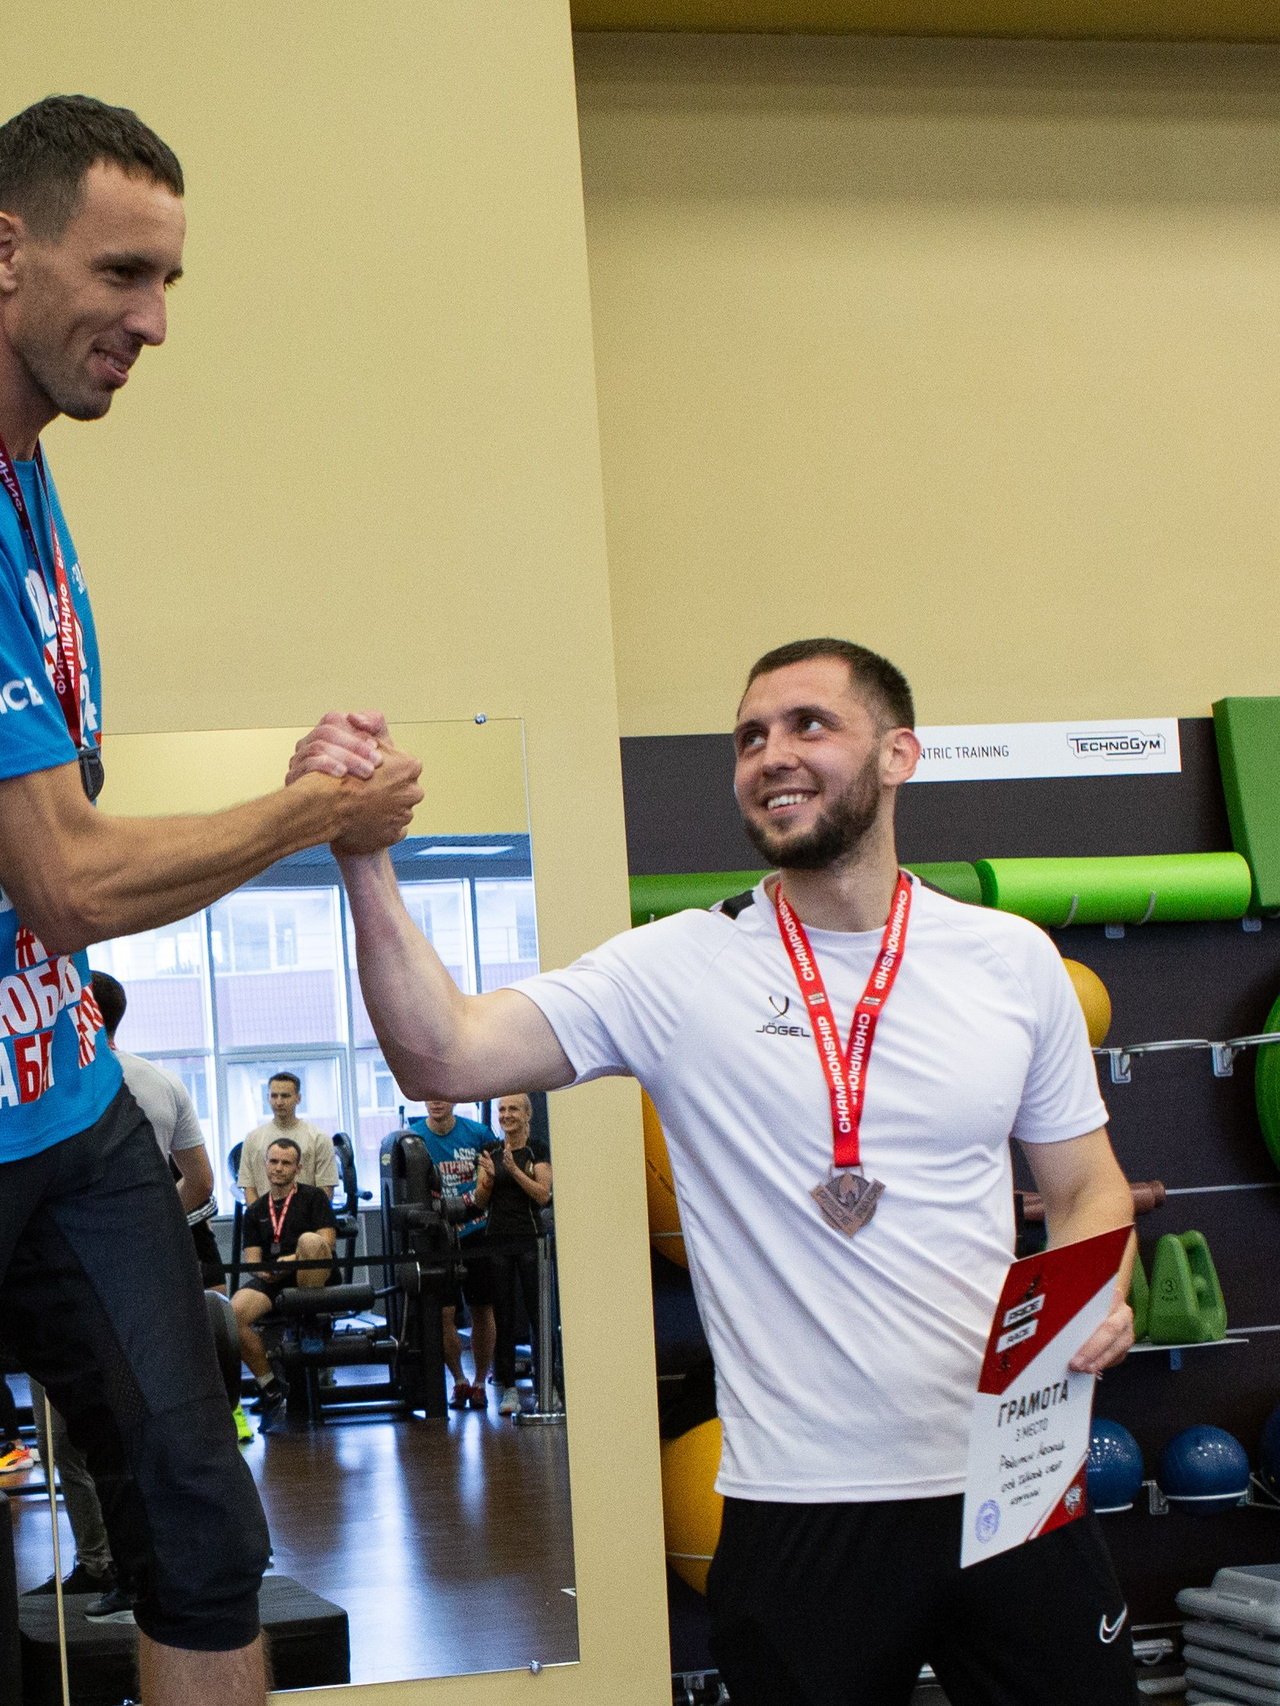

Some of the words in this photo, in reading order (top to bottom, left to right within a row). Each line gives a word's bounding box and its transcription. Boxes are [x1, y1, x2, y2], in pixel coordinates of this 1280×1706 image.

[955, 745, 1010, 760] TRAINING
[875, 889, 909, 990] CHAMPIONSHIP
[755, 1022, 811, 1038] JÖGEL
[817, 1016, 852, 1133] CHAMPIONSHIP
[997, 1379, 1069, 1428] ГРАМОТА
